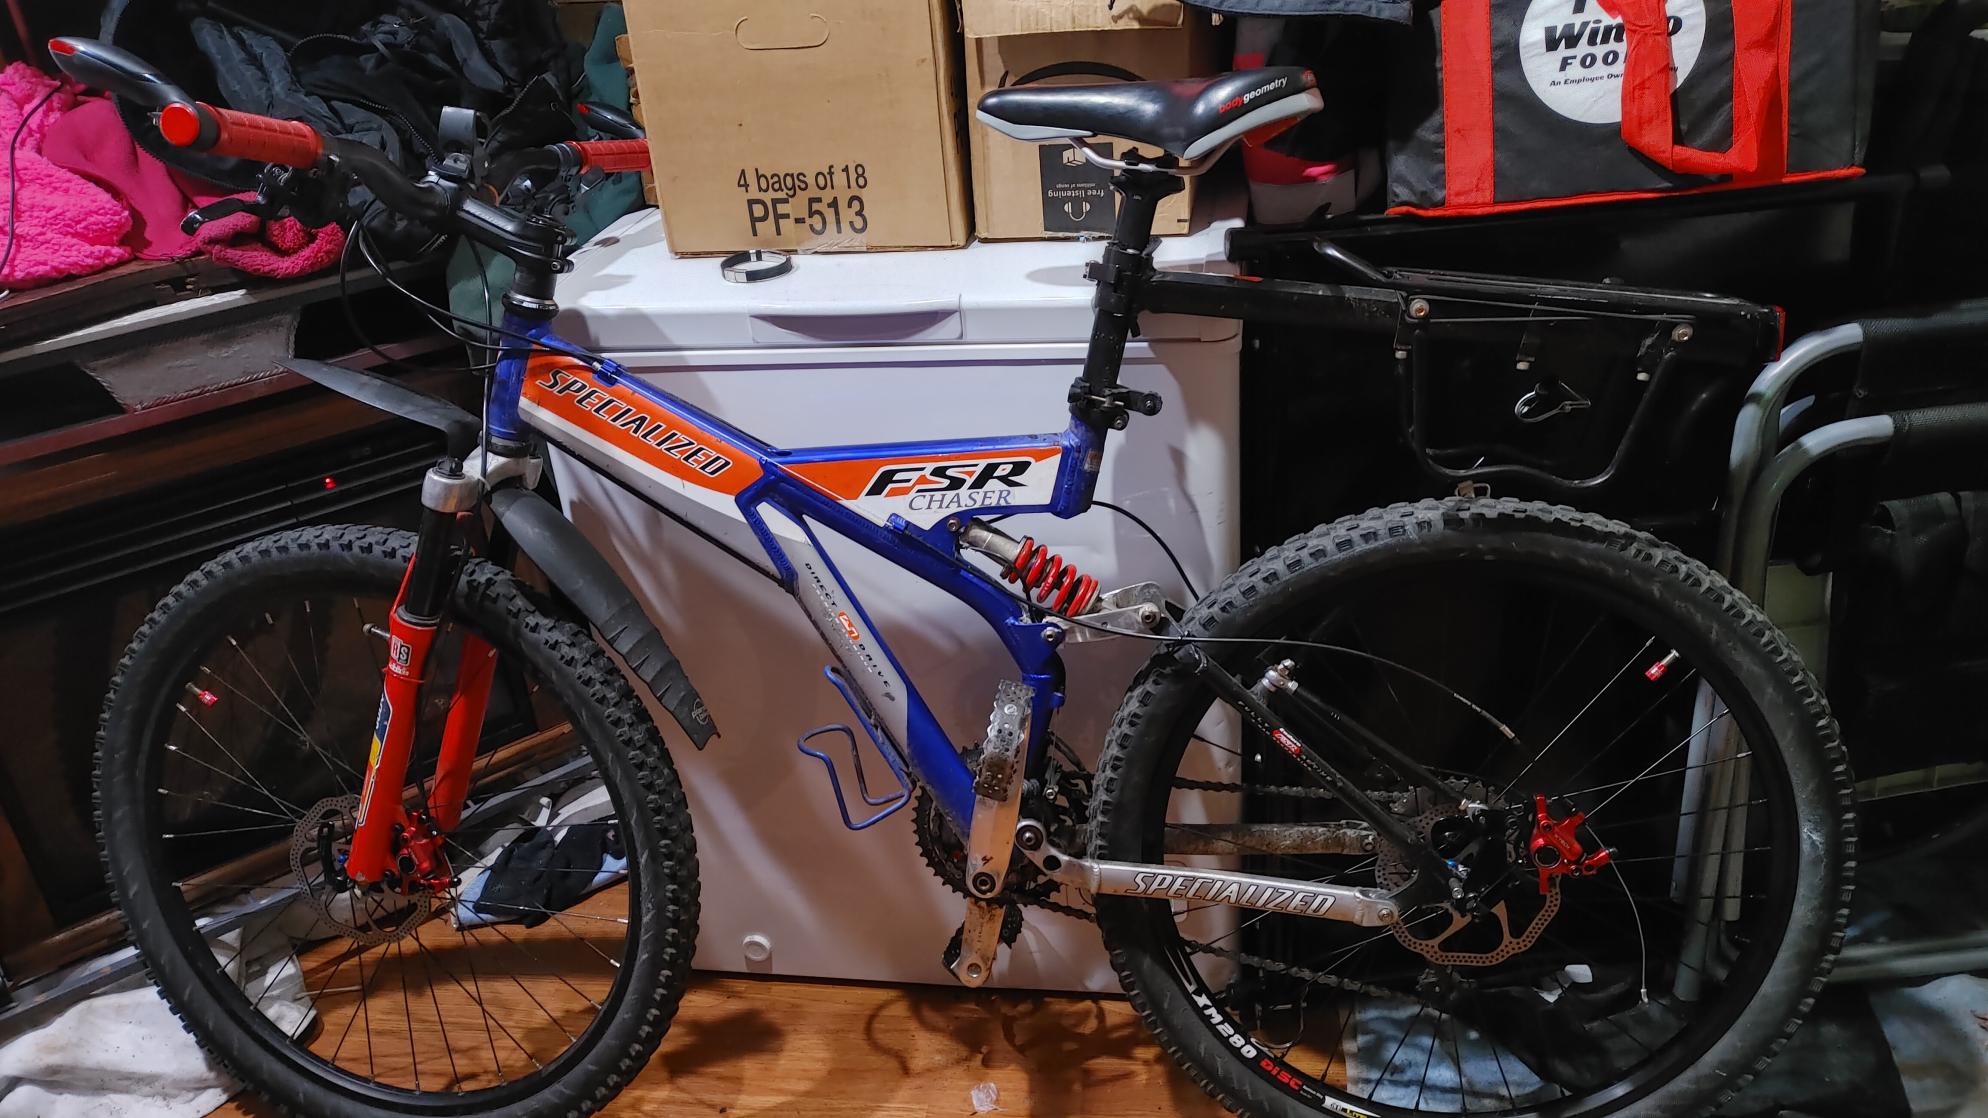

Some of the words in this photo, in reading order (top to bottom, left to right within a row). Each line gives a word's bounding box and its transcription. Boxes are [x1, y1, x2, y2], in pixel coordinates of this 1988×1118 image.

[1544, 16, 1683, 53] Wino
[1558, 50, 1627, 72] FOO
[1549, 79, 1562, 87] An
[1563, 74, 1605, 86] Employee
[737, 168, 750, 193] 4
[755, 167, 808, 198] bags
[814, 164, 835, 191] of
[841, 163, 868, 189] 18
[1047, 189, 1086, 199] listening
[1086, 189, 1105, 197] free
[746, 195, 868, 237] PF-513
[536, 368, 733, 478] SPECIALIZED
[864, 460, 1032, 497] FSR
[908, 489, 1012, 511] CHASER
[804, 562, 838, 608] DIRECT
[858, 643, 891, 688] DRIVE
[1125, 871, 1337, 917] SPECIALIZED
[1191, 993, 1258, 1059] XM280
[1259, 1056, 1305, 1091] DISC
